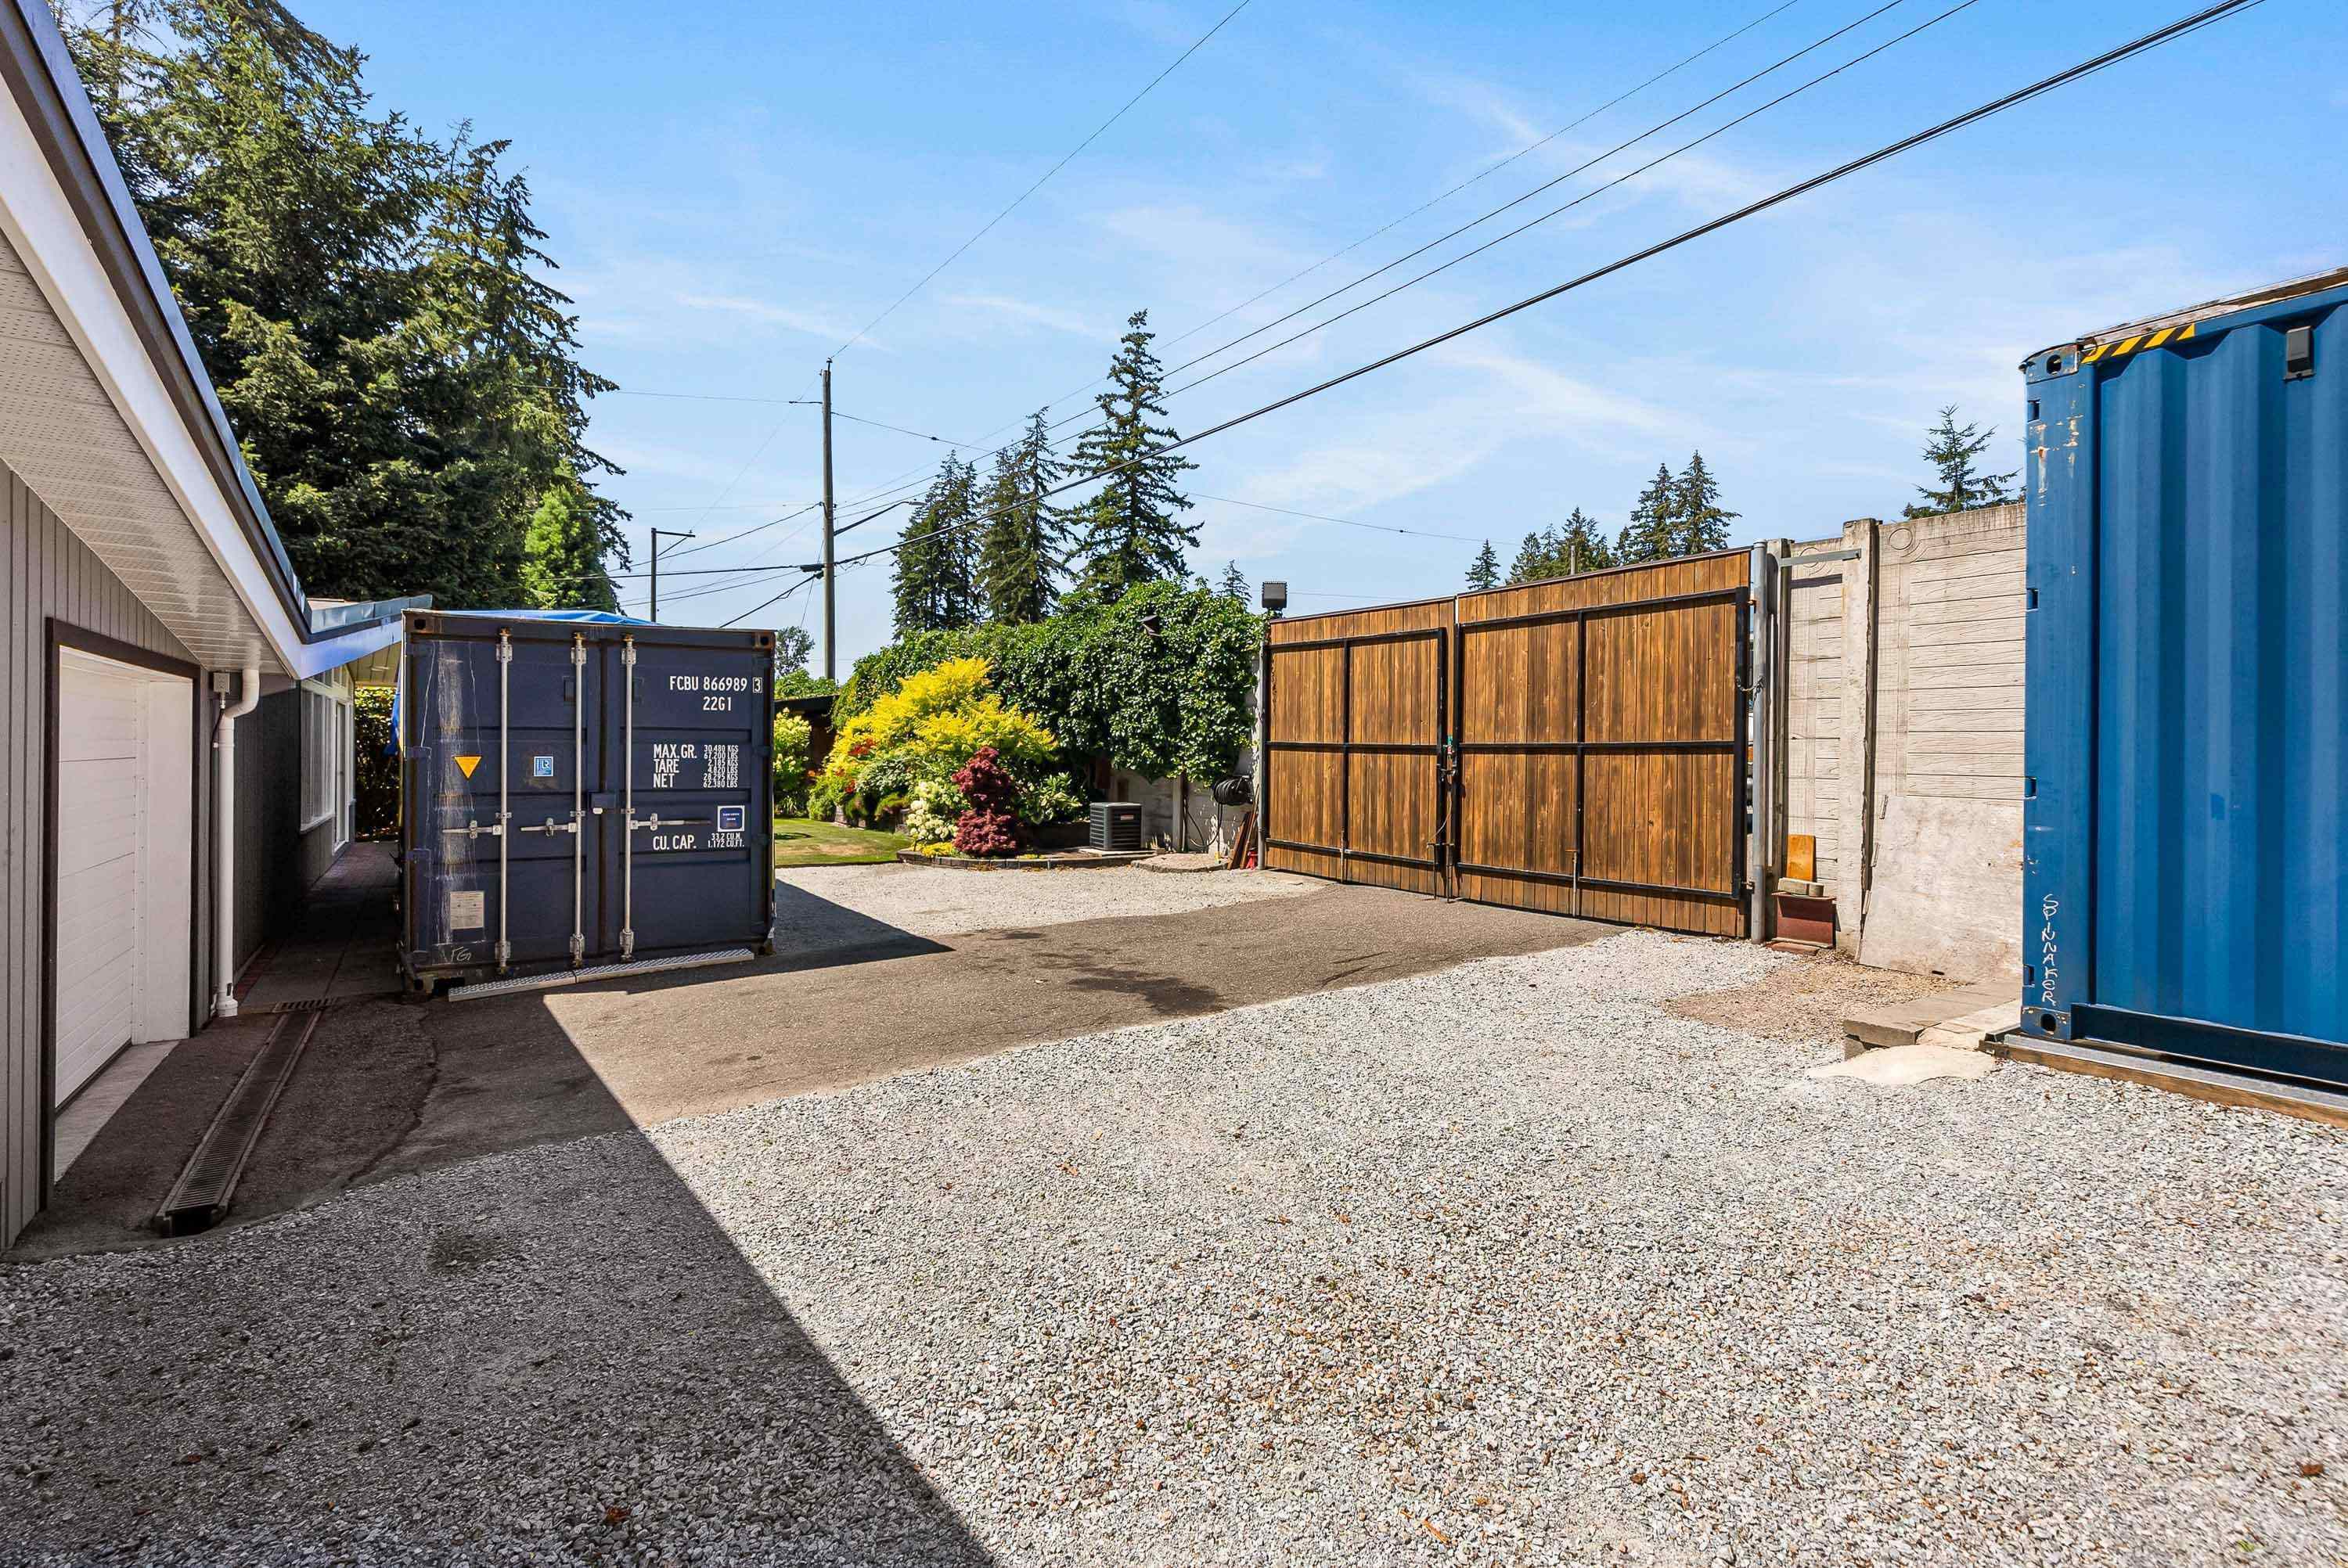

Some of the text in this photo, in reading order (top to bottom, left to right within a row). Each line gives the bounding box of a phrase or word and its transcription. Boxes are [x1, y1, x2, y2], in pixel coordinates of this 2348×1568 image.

[669, 675, 762, 692] FCBU 866989 3
[703, 696, 732, 711] 22G1
[653, 758, 680, 773] TARE
[653, 773, 675, 788] NET
[653, 834, 697, 851] CU. CAP.
[2041, 894, 2059, 1007] SPINNAKER
